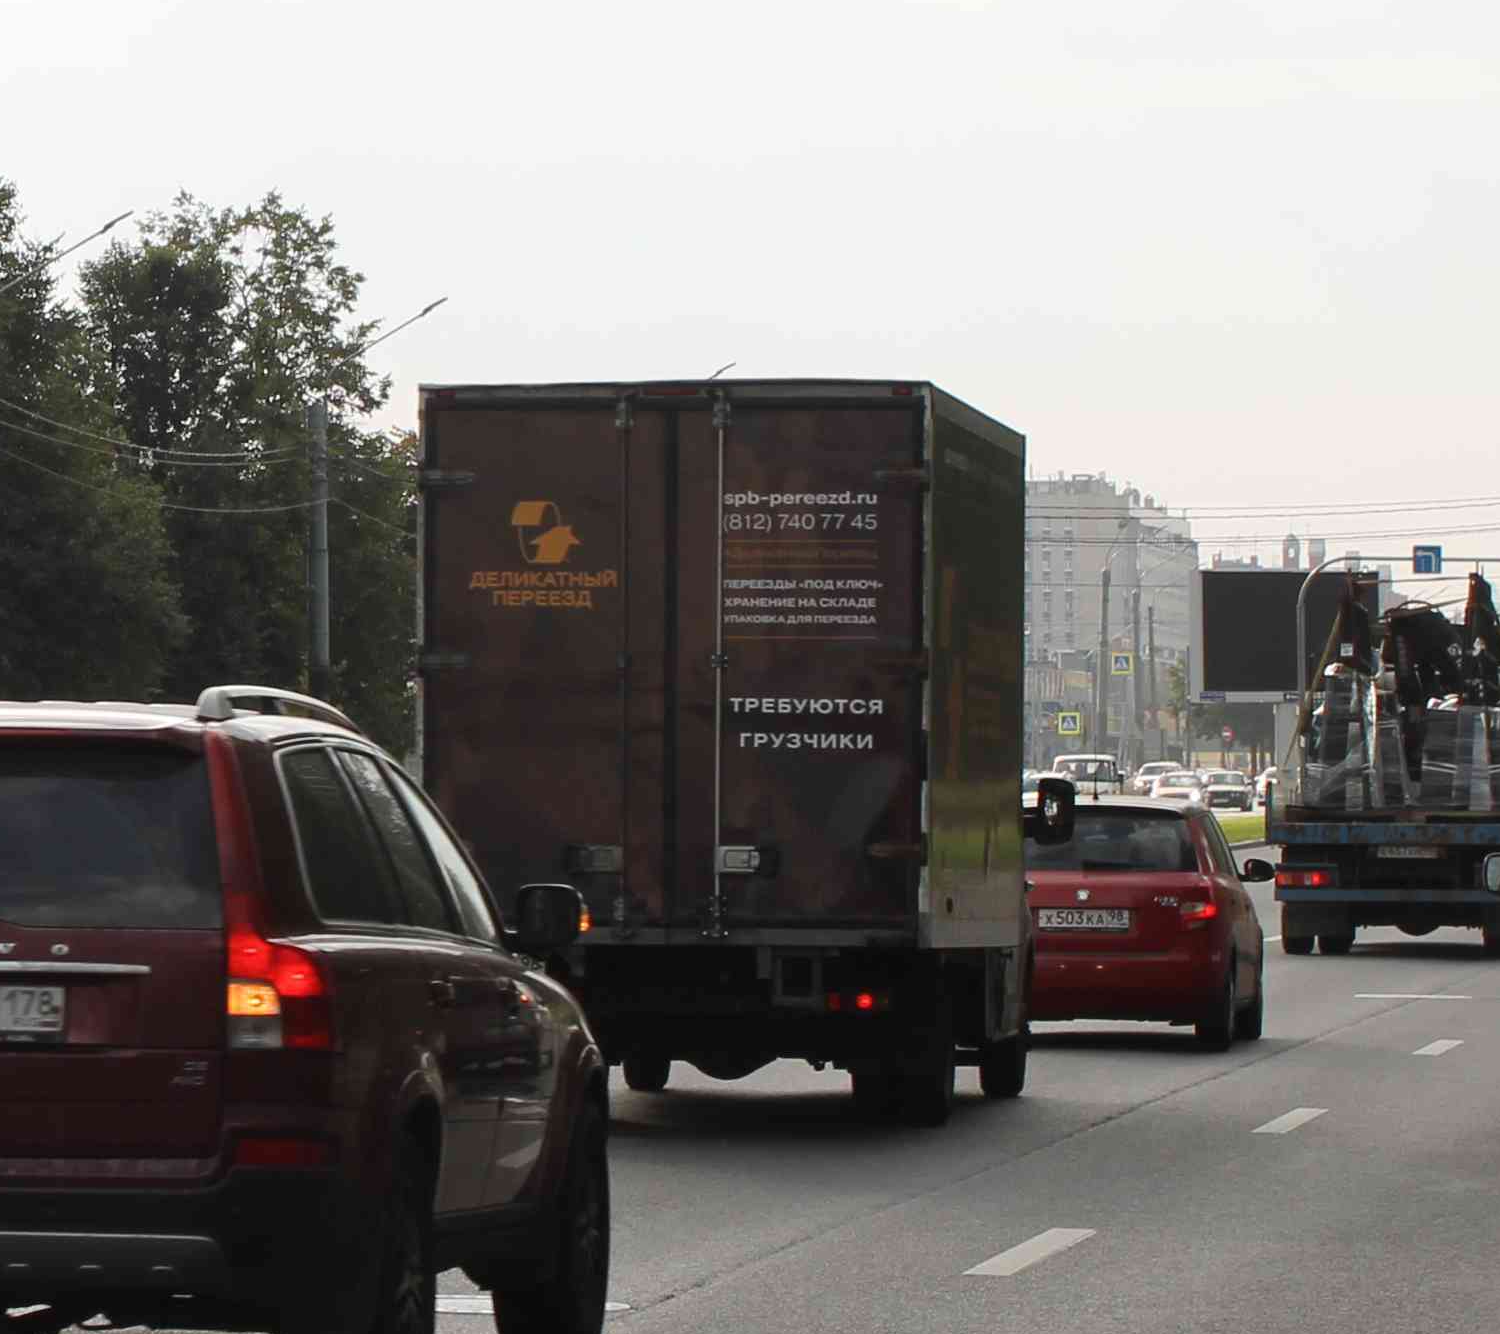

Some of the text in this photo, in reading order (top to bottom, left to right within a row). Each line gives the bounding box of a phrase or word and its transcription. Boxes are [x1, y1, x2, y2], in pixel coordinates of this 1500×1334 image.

[724, 490, 878, 507] spb-pereezd.ru
[723, 514, 878, 533] (812) 740 77 45
[468, 569, 618, 589] ДЕЛИКАТНЫЙ
[723, 579, 797, 590] ПЕРЕЕЗДЫ
[492, 589, 593, 609] ПЕРЕЕЗД
[723, 597, 877, 609] ХРАНЕНИЕ НА СКЛАДЕ
[723, 615, 877, 625] УПАКОВКА ДЛЯ ПЕРЕЕЗДА
[729, 697, 884, 715] ТРЕБУЮТСЯ
[739, 732, 874, 749] ГРУЗЧИКИ
[3, 989, 55, 1015] 178
